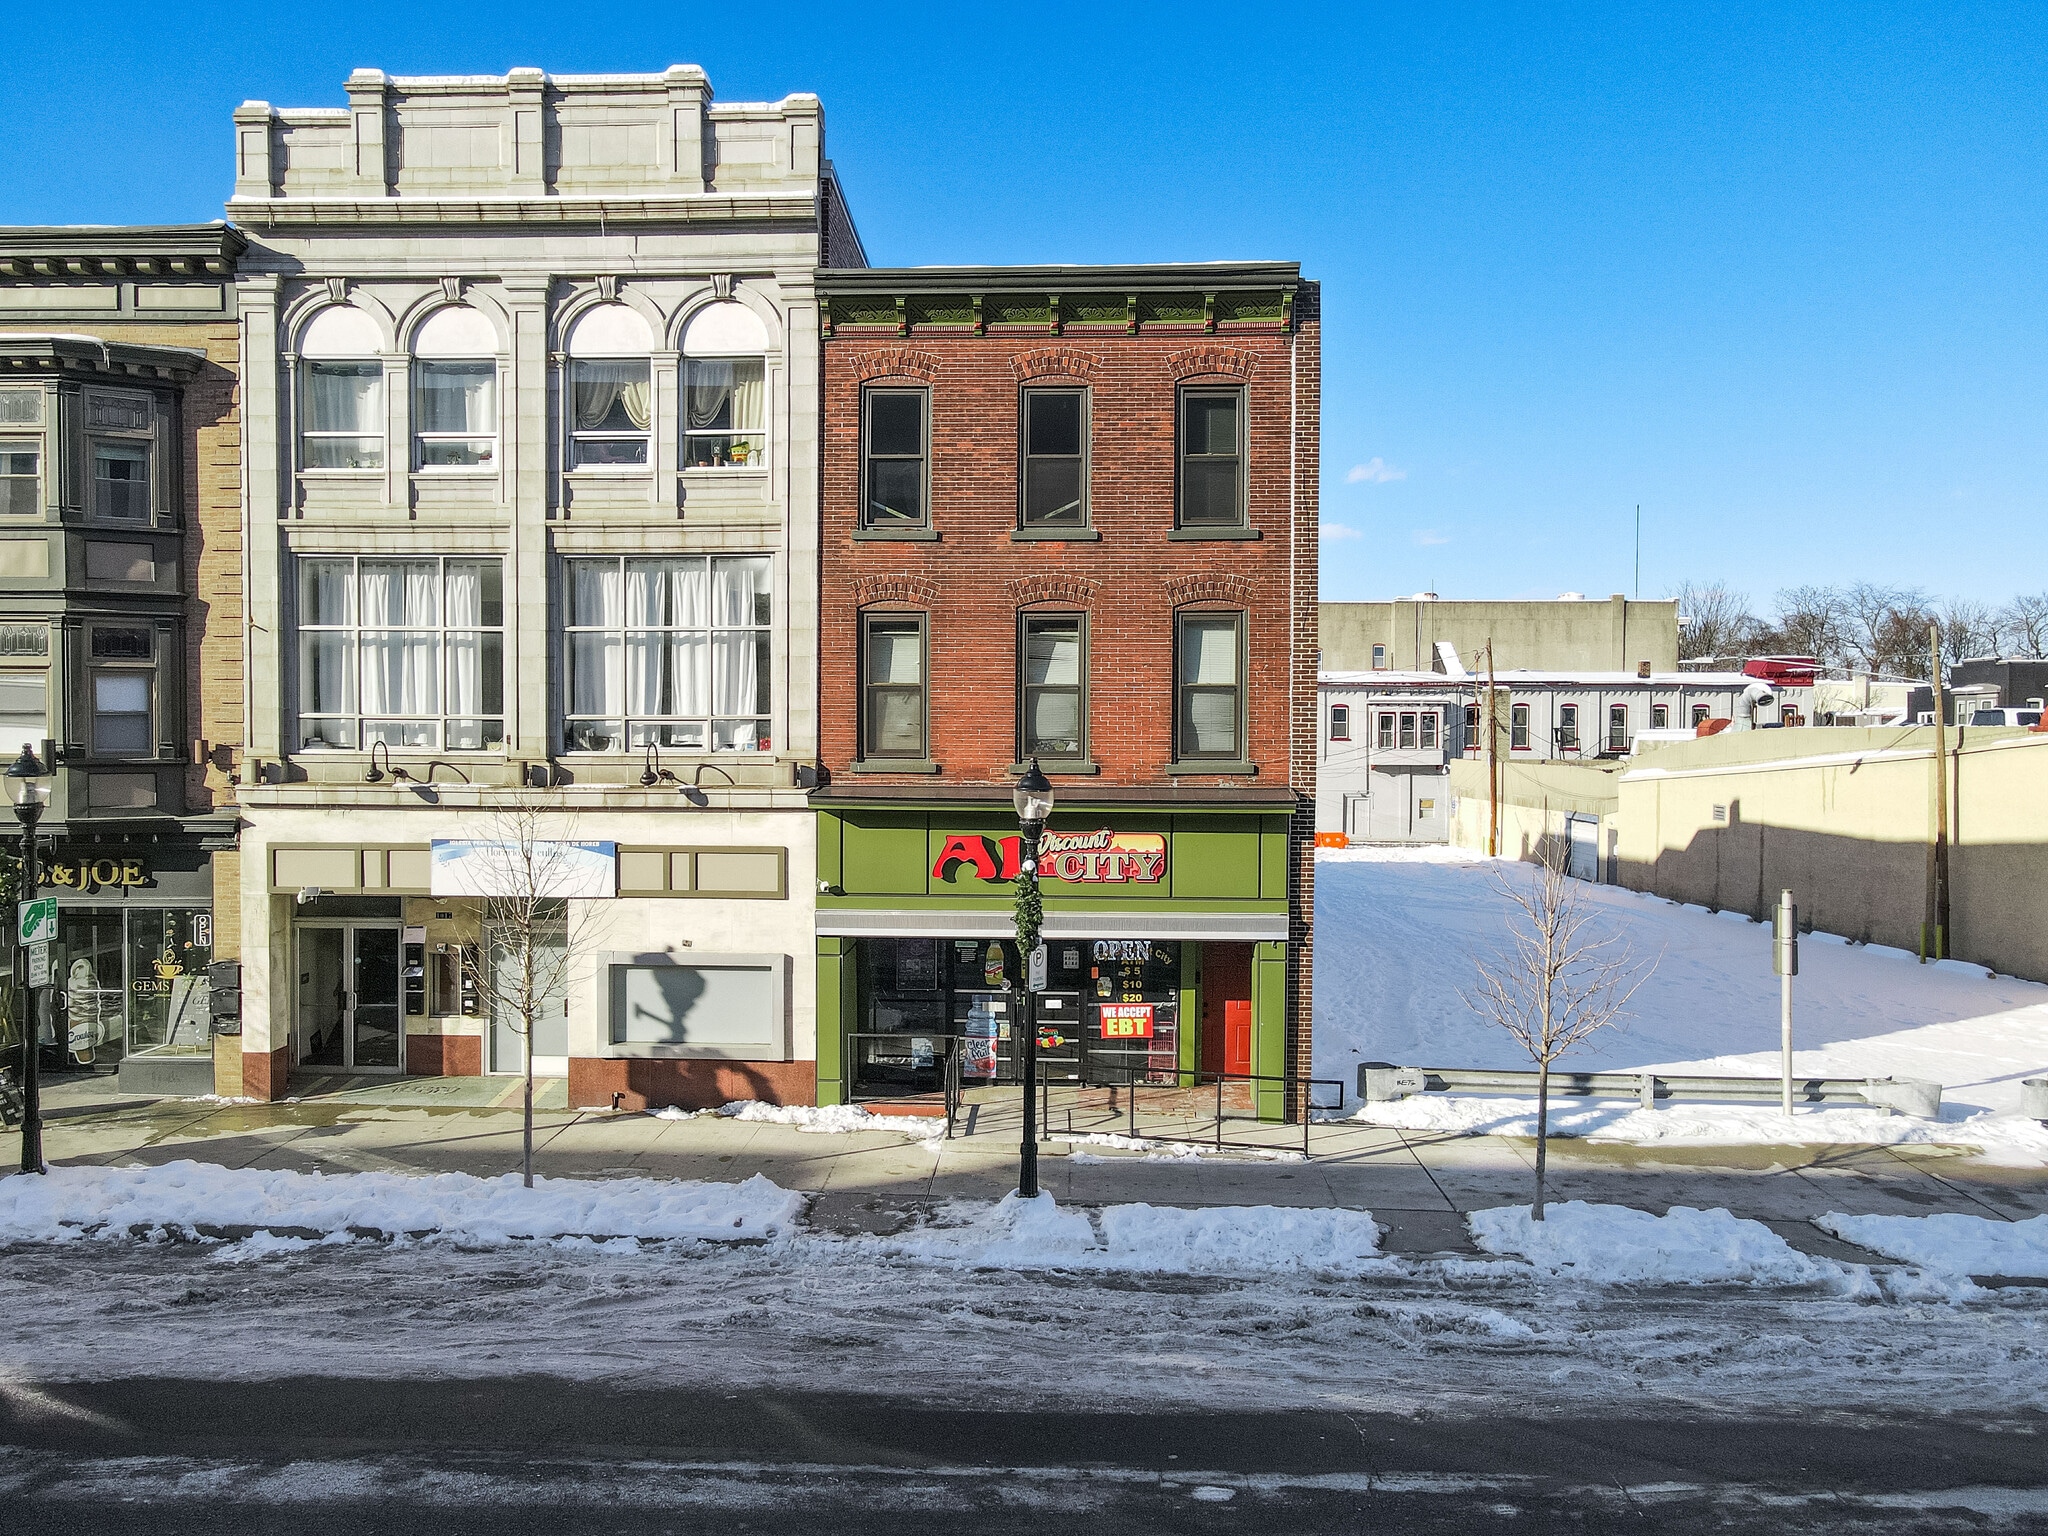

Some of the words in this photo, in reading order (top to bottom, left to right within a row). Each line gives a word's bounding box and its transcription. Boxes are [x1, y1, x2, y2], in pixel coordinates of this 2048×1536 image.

[1038, 830, 1109, 855] Discount
[52, 863, 73, 885] &
[77, 858, 144, 891] JOE
[1054, 852, 1162, 881] CITY
[199, 916, 207, 945] OPEN
[1093, 940, 1151, 961] OPEN
[1155, 949, 1173, 965] City
[132, 981, 170, 992] GEMS
[1122, 980, 1142, 989] $10
[1122, 994, 1143, 1003] $20
[1102, 1007, 1117, 1018] WE
[1118, 1007, 1151, 1018] ACCEPT
[1106, 1018, 1147, 1036] EBT
